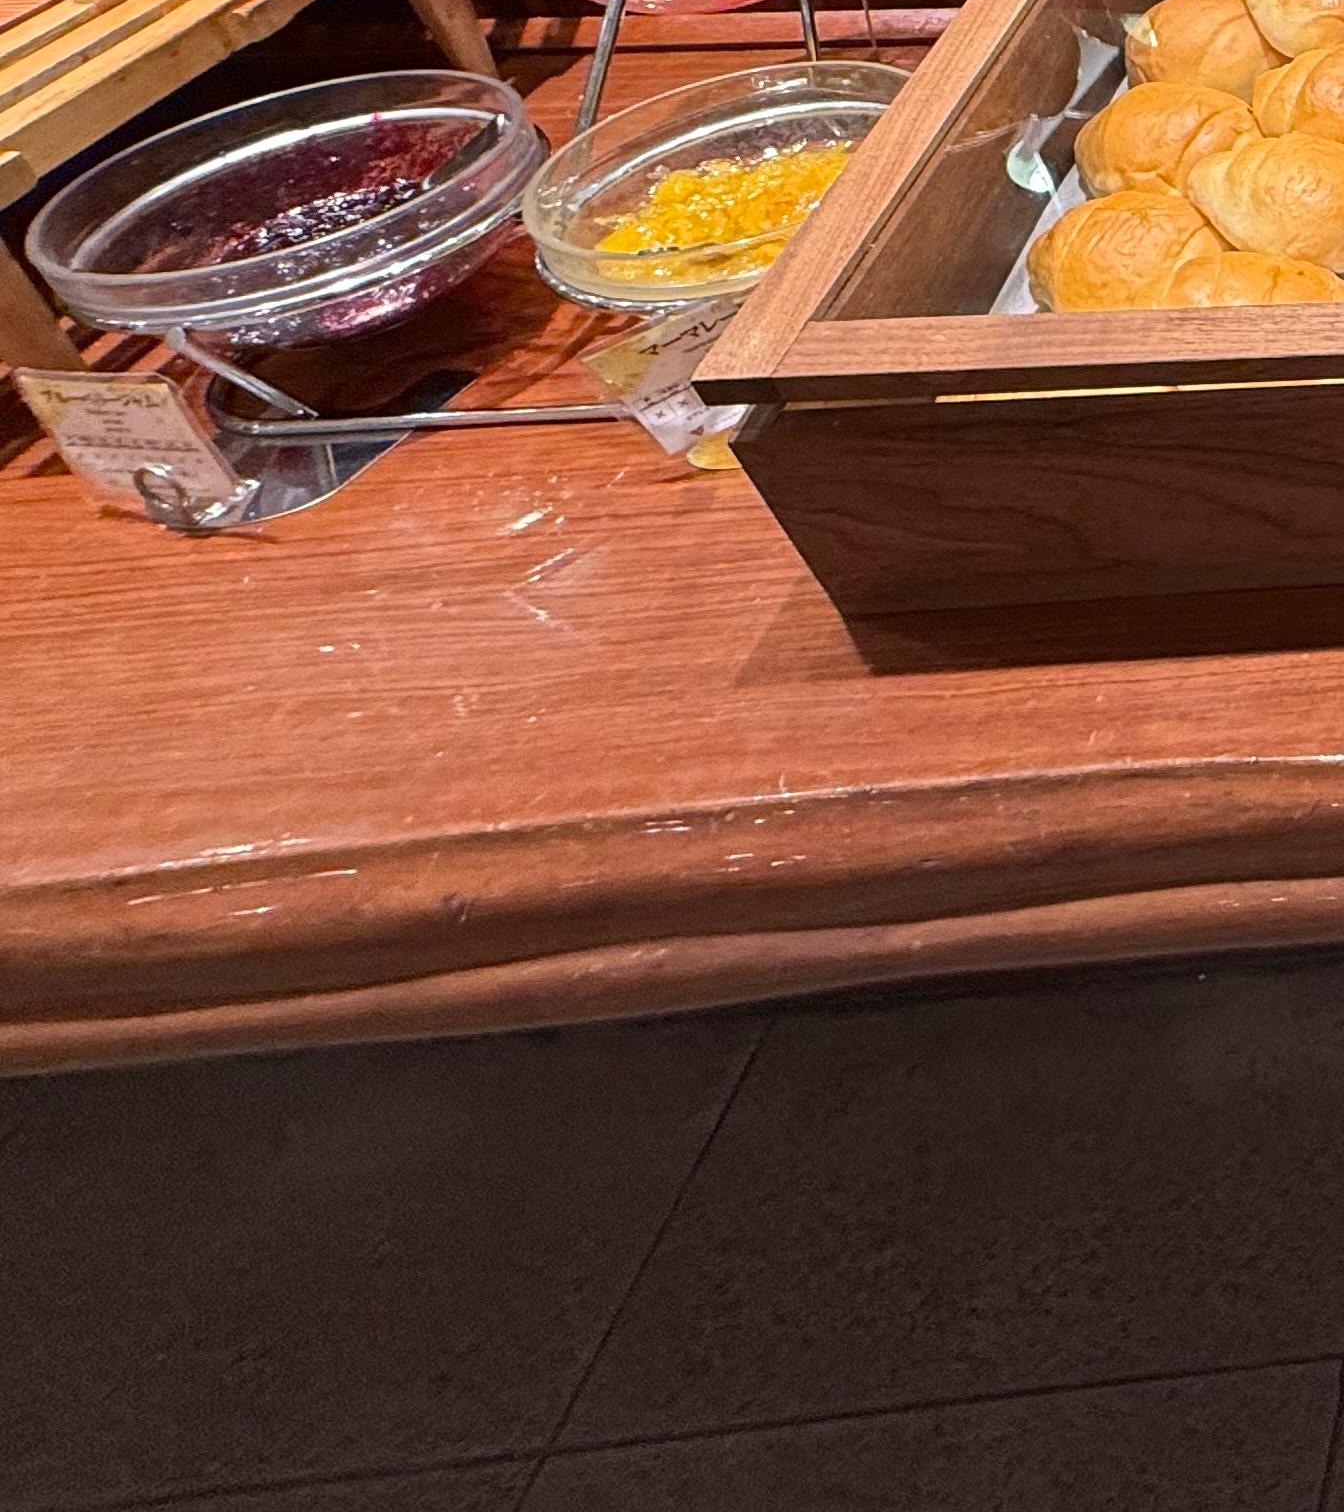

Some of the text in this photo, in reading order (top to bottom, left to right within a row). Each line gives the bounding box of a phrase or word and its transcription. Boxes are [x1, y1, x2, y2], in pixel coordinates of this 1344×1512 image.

[640, 311, 738, 355] マーマレー
